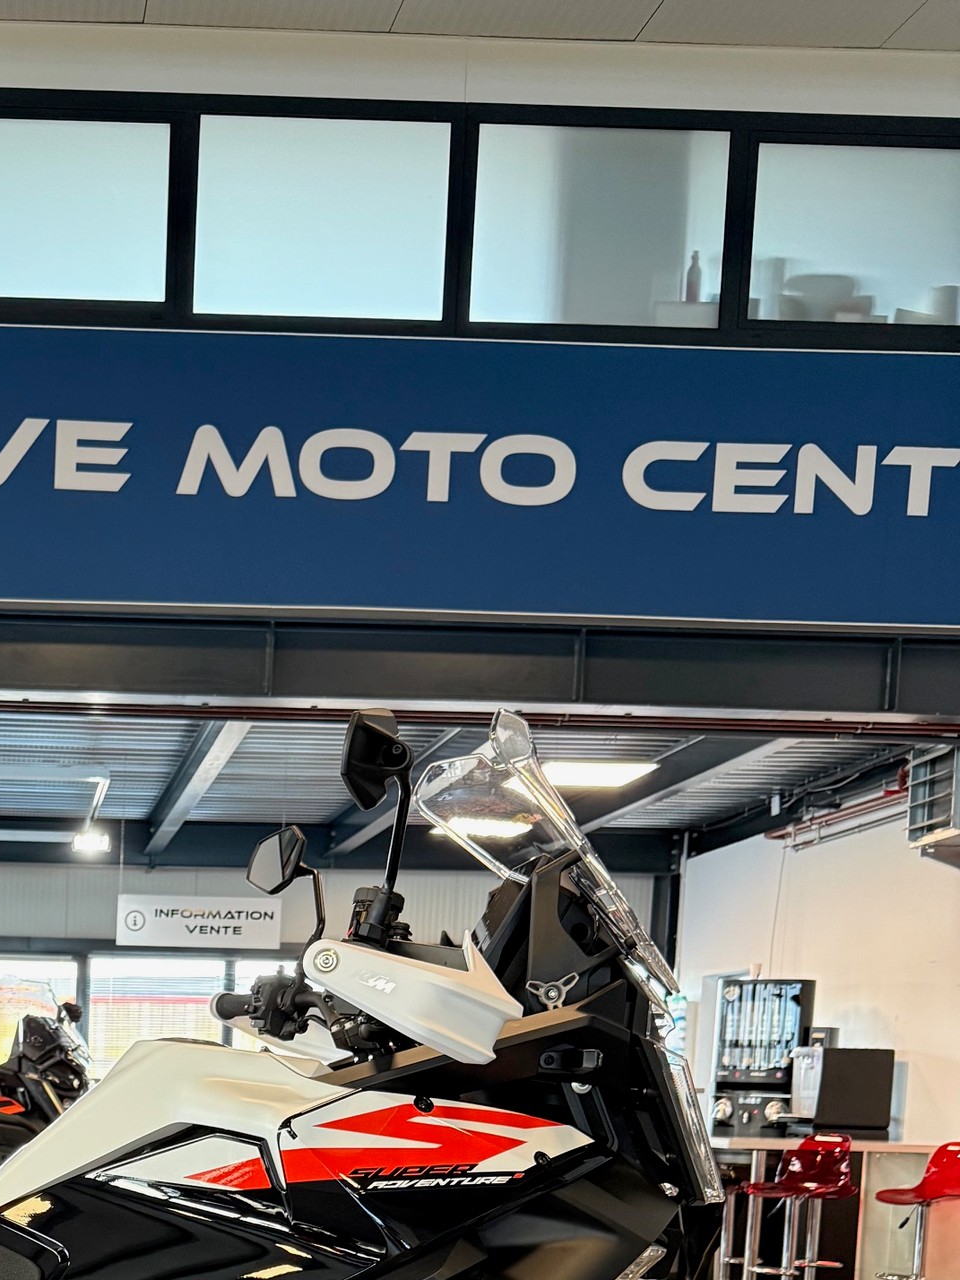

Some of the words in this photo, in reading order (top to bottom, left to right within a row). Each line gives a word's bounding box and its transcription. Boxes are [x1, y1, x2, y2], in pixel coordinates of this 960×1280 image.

[176, 424, 576, 506] MOTO
[622, 440, 960, 517] CENT
[154, 908, 275, 921] INFORMATION
[185, 925, 243, 936] VENTE
[348, 1163, 479, 1179] SUPER
[366, 1175, 513, 1190] ADVENTURE
